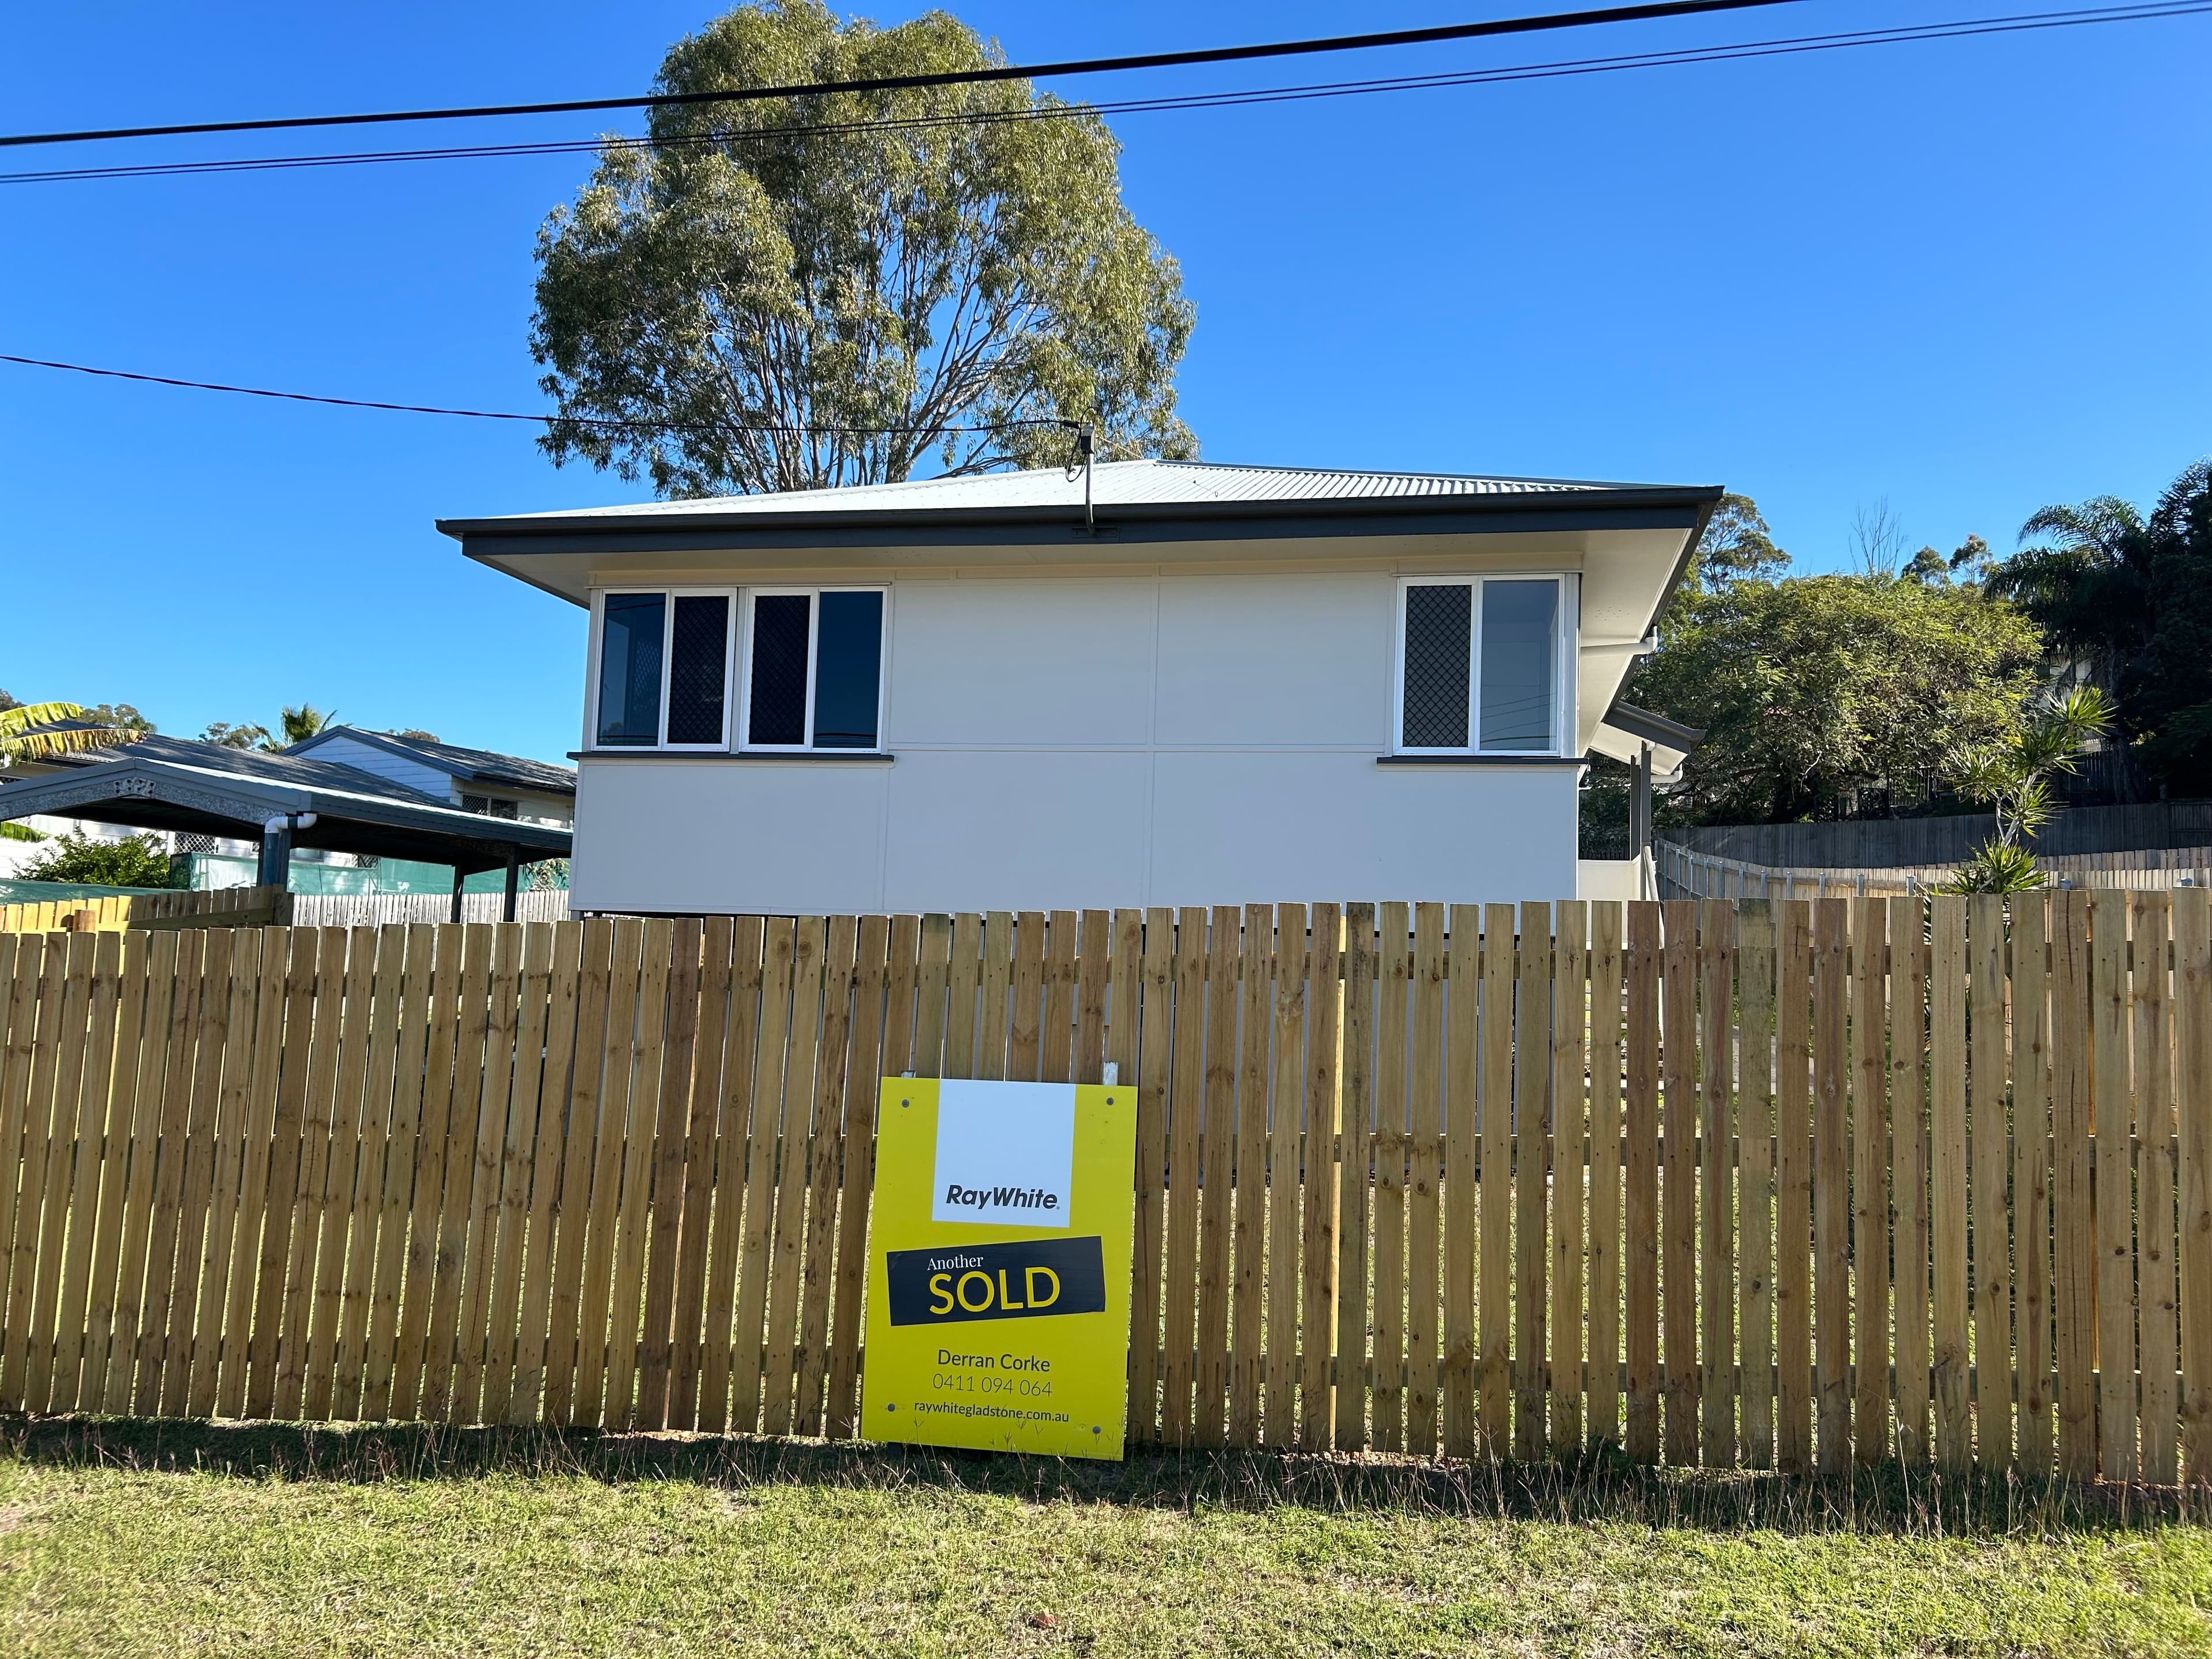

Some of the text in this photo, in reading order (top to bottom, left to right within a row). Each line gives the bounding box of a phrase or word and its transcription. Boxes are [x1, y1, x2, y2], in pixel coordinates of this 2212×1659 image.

[927, 1255, 983, 1270] Another
[929, 1267, 1060, 1315] SOLD
[938, 1350, 1050, 1372] Derran Corke
[933, 1373, 1052, 1397] 0411 094 064
[914, 1401, 1069, 1422] raywhitegladstone.com.au
